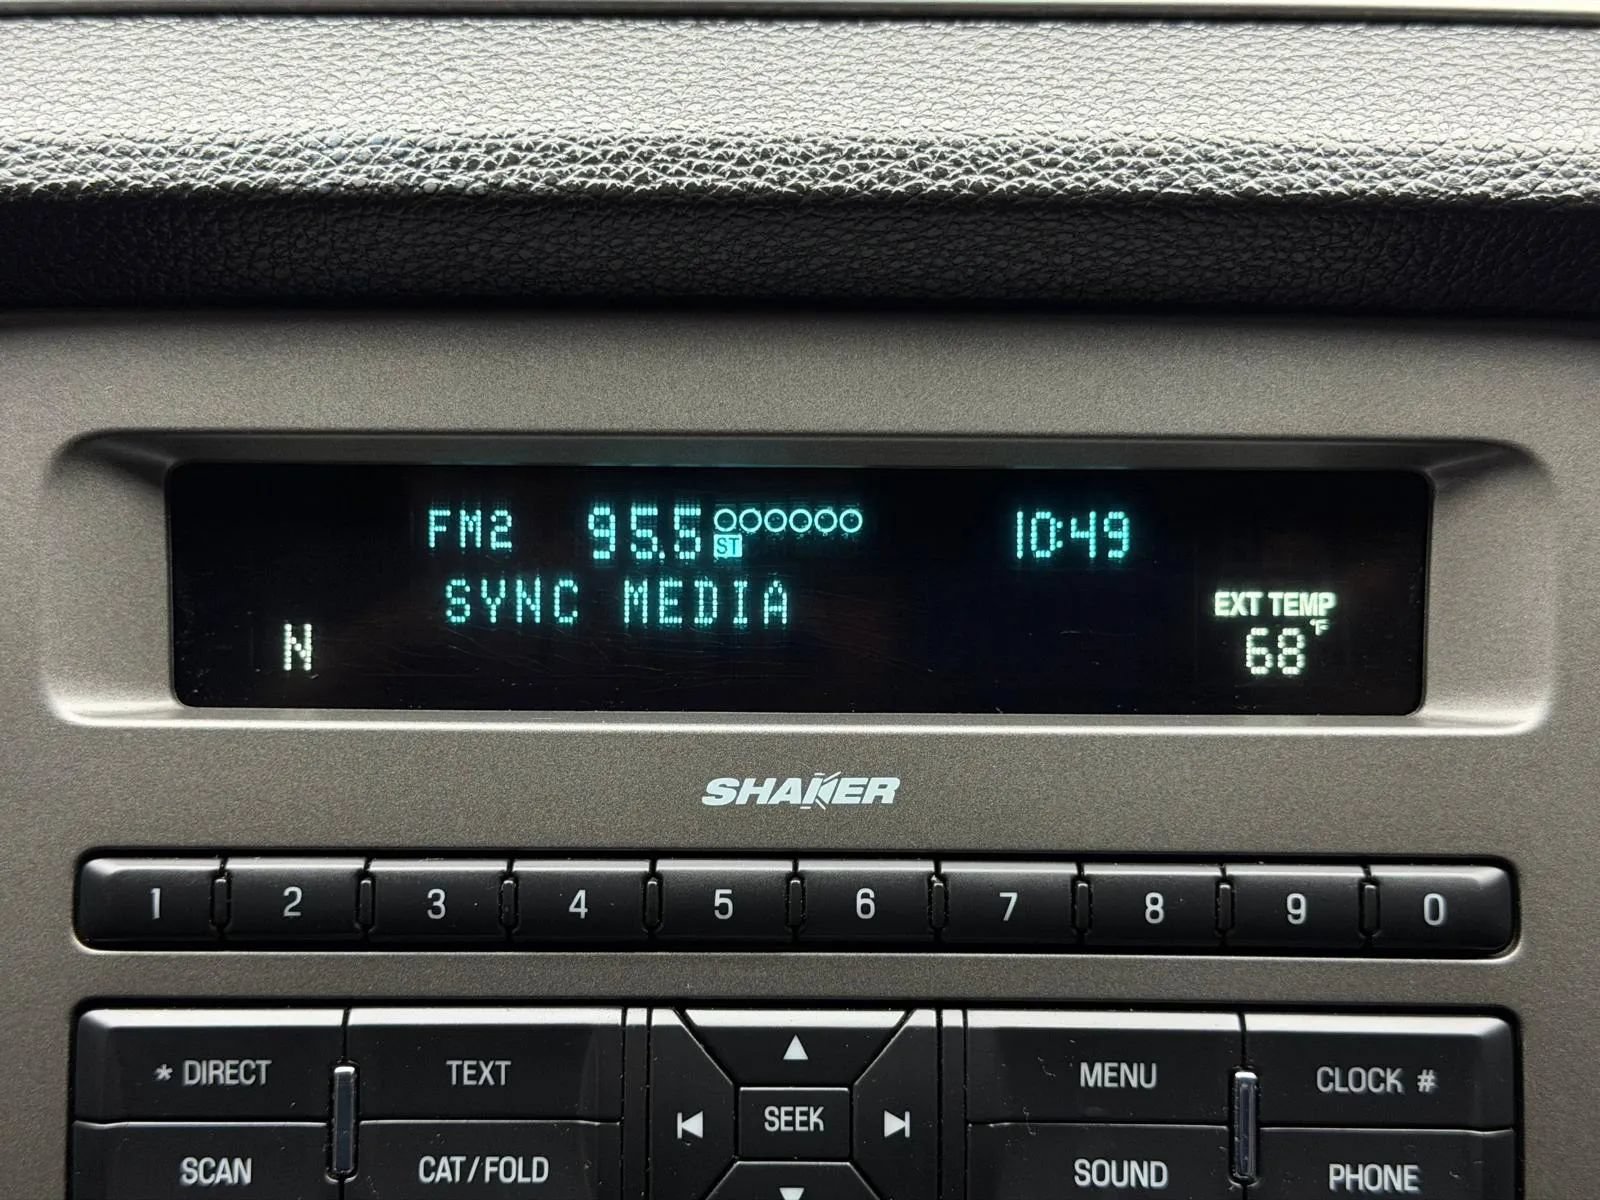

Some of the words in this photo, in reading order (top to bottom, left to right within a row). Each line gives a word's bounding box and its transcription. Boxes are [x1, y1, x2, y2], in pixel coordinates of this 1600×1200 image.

[429, 509, 512, 549] FM2
[588, 507, 701, 561] 95.5
[1017, 511, 1129, 558] 10:49
[715, 535, 743, 559] ST
[446, 577, 578, 625] SYNC
[624, 579, 787, 626] MEDIA
[1215, 590, 1262, 617] EXT
[1268, 592, 1336, 616] TEMP
[284, 624, 312, 670] N
[1246, 628, 1305, 675] 68
[702, 774, 900, 808] SHAKER
[151, 887, 161, 919] 1
[284, 887, 302, 916] 2
[428, 889, 445, 918] 3
[569, 890, 587, 918] 4
[715, 889, 733, 919] 5
[857, 888, 875, 918] 6
[1000, 892, 1017, 920] 7
[1146, 892, 1163, 923] 8
[1287, 893, 1306, 924] 9
[1424, 892, 1446, 925] 0
[185, 1060, 271, 1084] DIRECT
[447, 1061, 511, 1085] TEXT
[1081, 1063, 1156, 1088] MENU
[1317, 1067, 1402, 1092] CLOCK
[765, 1106, 823, 1131] SEEK
[182, 1157, 251, 1184] SCAN
[419, 1156, 548, 1183] CAT/FOLD
[1075, 1159, 1167, 1187] SOUND
[1330, 1164, 1418, 1192] PHONE
